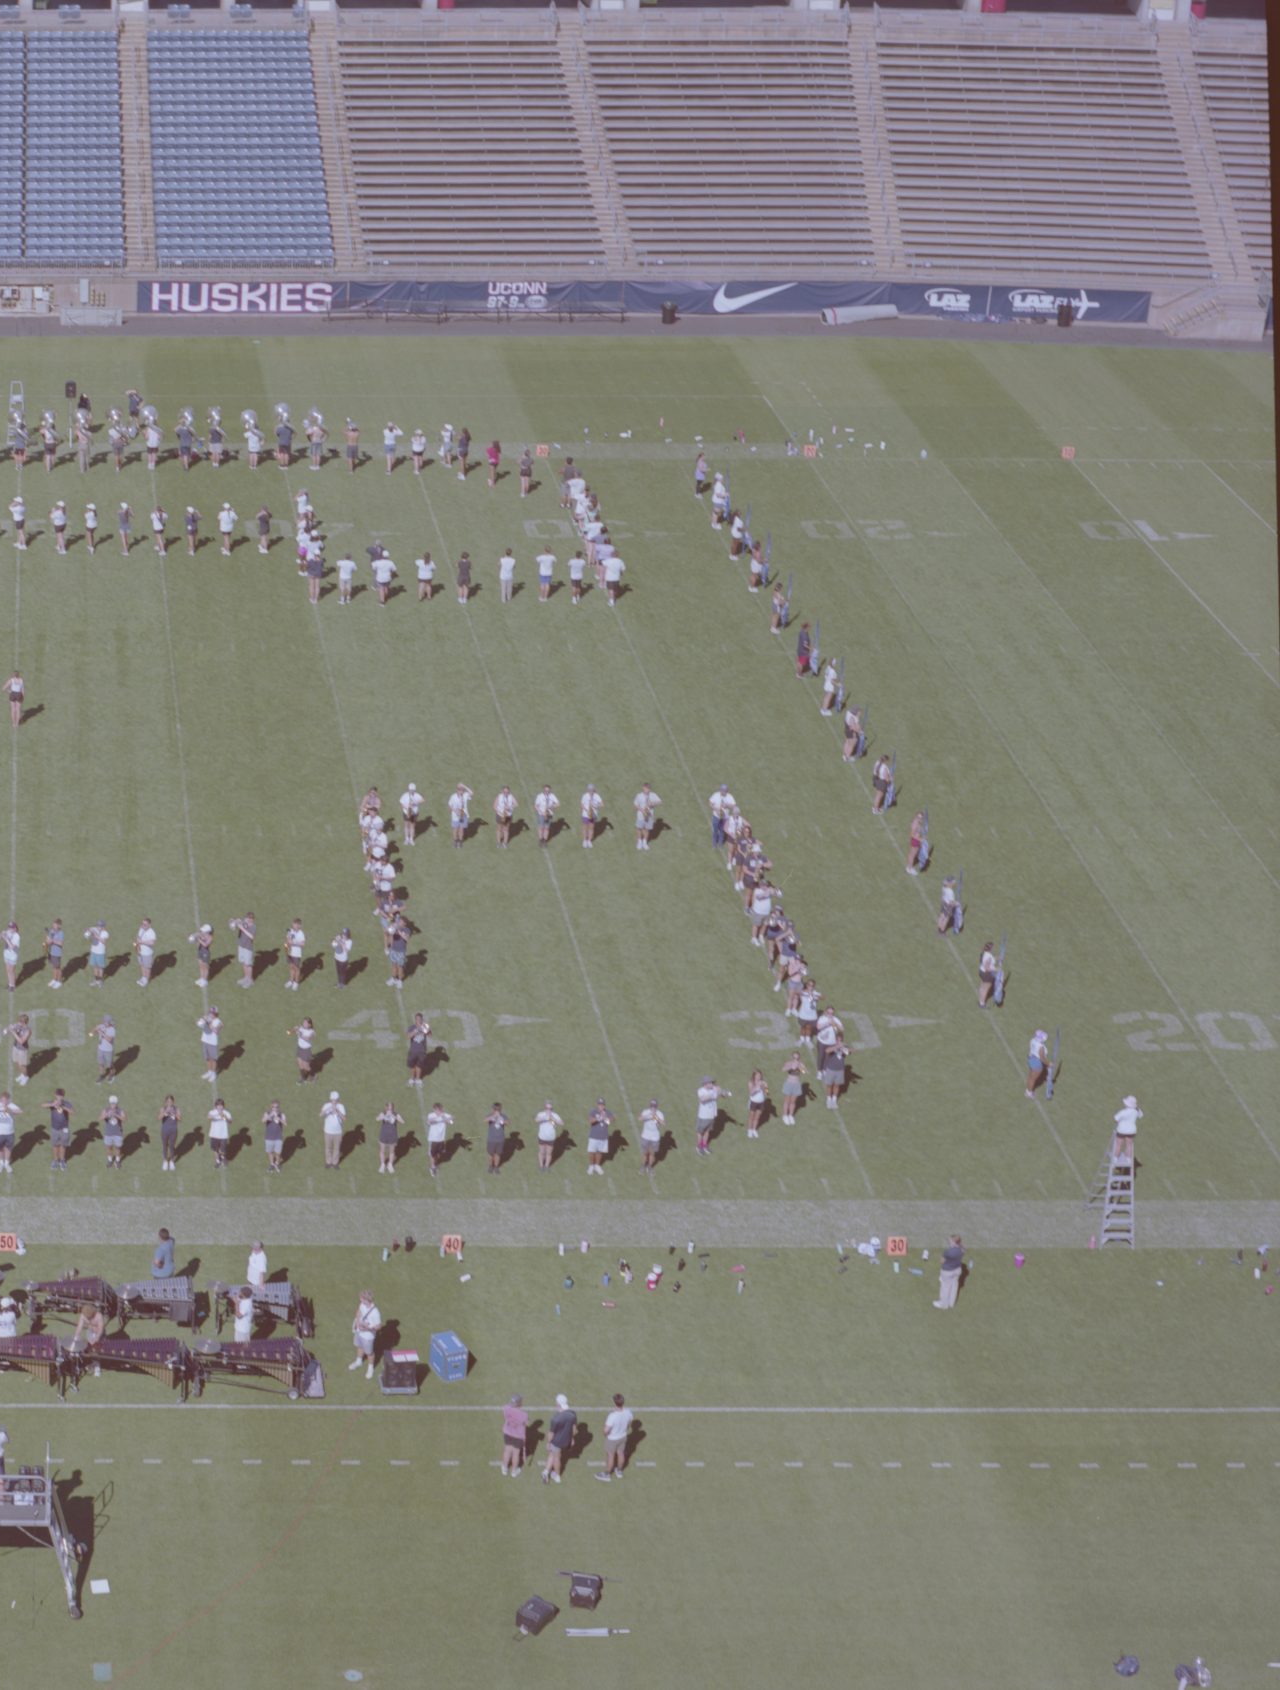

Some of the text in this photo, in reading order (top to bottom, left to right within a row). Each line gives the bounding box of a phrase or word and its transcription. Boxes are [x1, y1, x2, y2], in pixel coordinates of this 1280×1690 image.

[488, 282, 548, 295] UCONN
[152, 282, 332, 312] HUSKIES
[929, 294, 971, 307] LAZ
[1013, 294, 1054, 308] LAZ
[328, 1009, 484, 1049] 40
[1113, 1011, 1279, 1051] 20
[0, 1235, 13, 1249] 50
[446, 1237, 459, 1250] 40
[891, 1238, 904, 1252] 30
